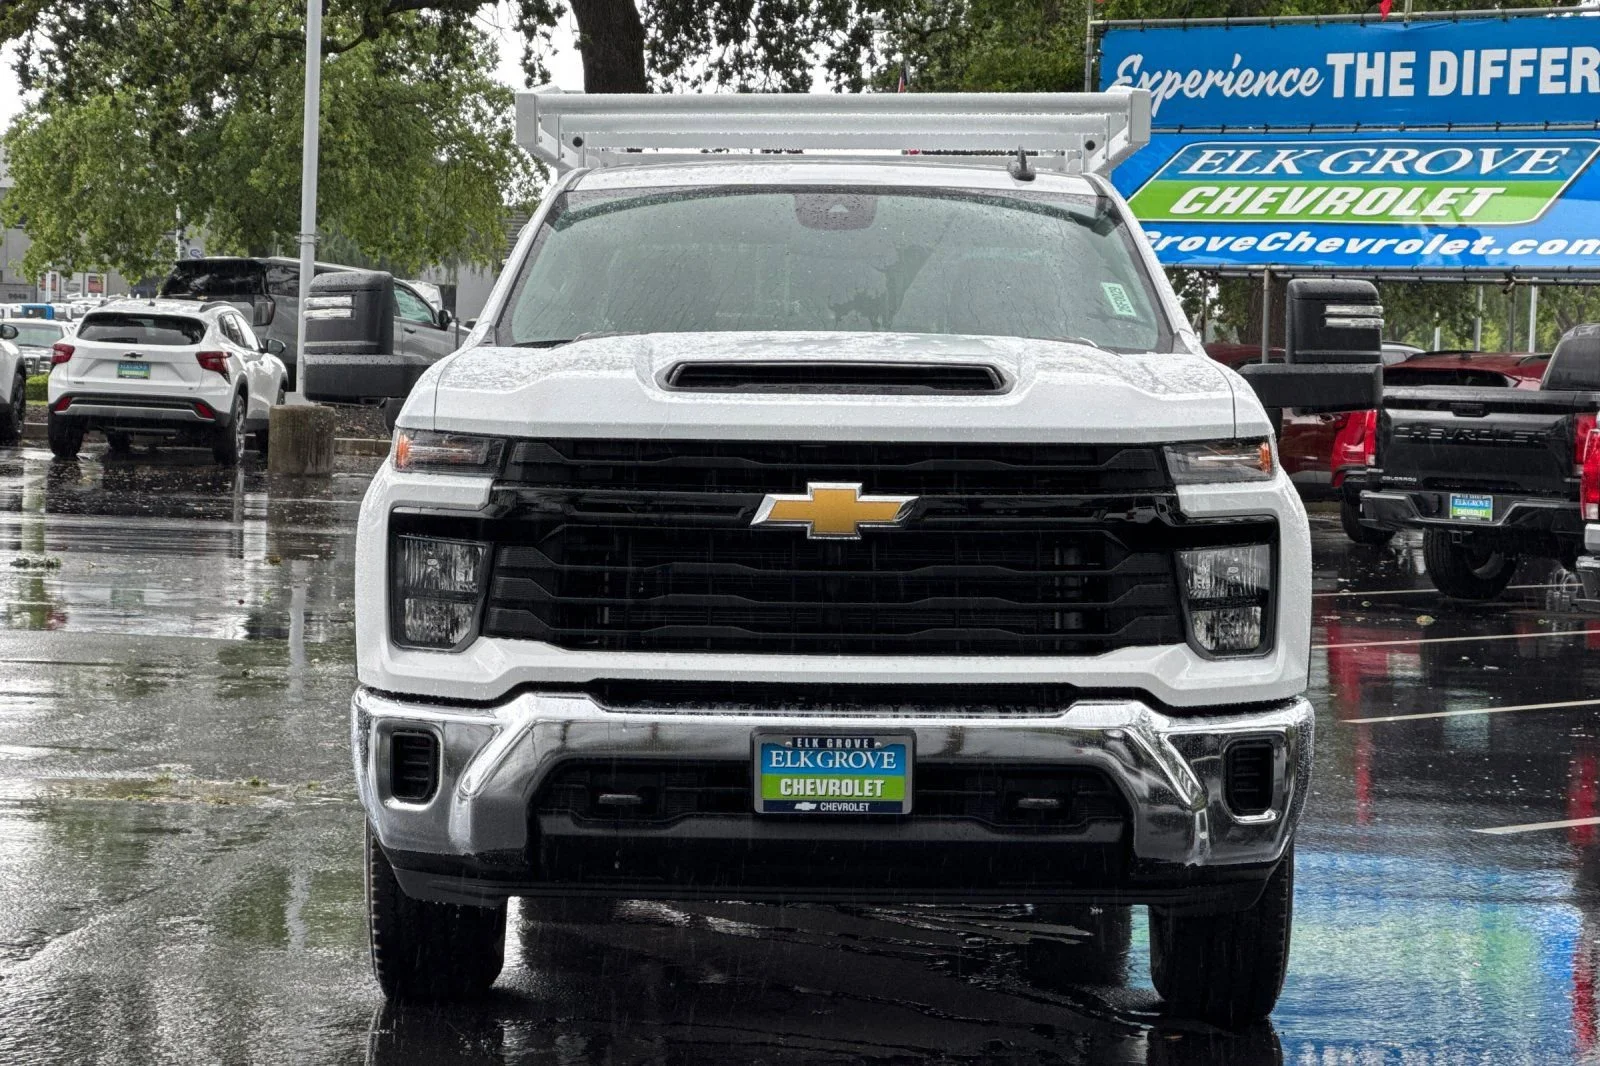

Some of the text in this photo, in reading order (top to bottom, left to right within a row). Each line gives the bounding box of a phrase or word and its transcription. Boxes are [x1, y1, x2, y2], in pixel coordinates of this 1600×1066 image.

[1108, 46, 1600, 117] Experience THE DIFFER
[1178, 147, 1570, 175] ELK GROVE
[1169, 186, 1507, 217] CHEVROLET
[797, 738, 869, 748] ELK GROVE
[769, 750, 897, 769] ELK GROVE
[780, 778, 885, 797] CHEVROLET
[820, 802, 870, 812] CHEVROLET
